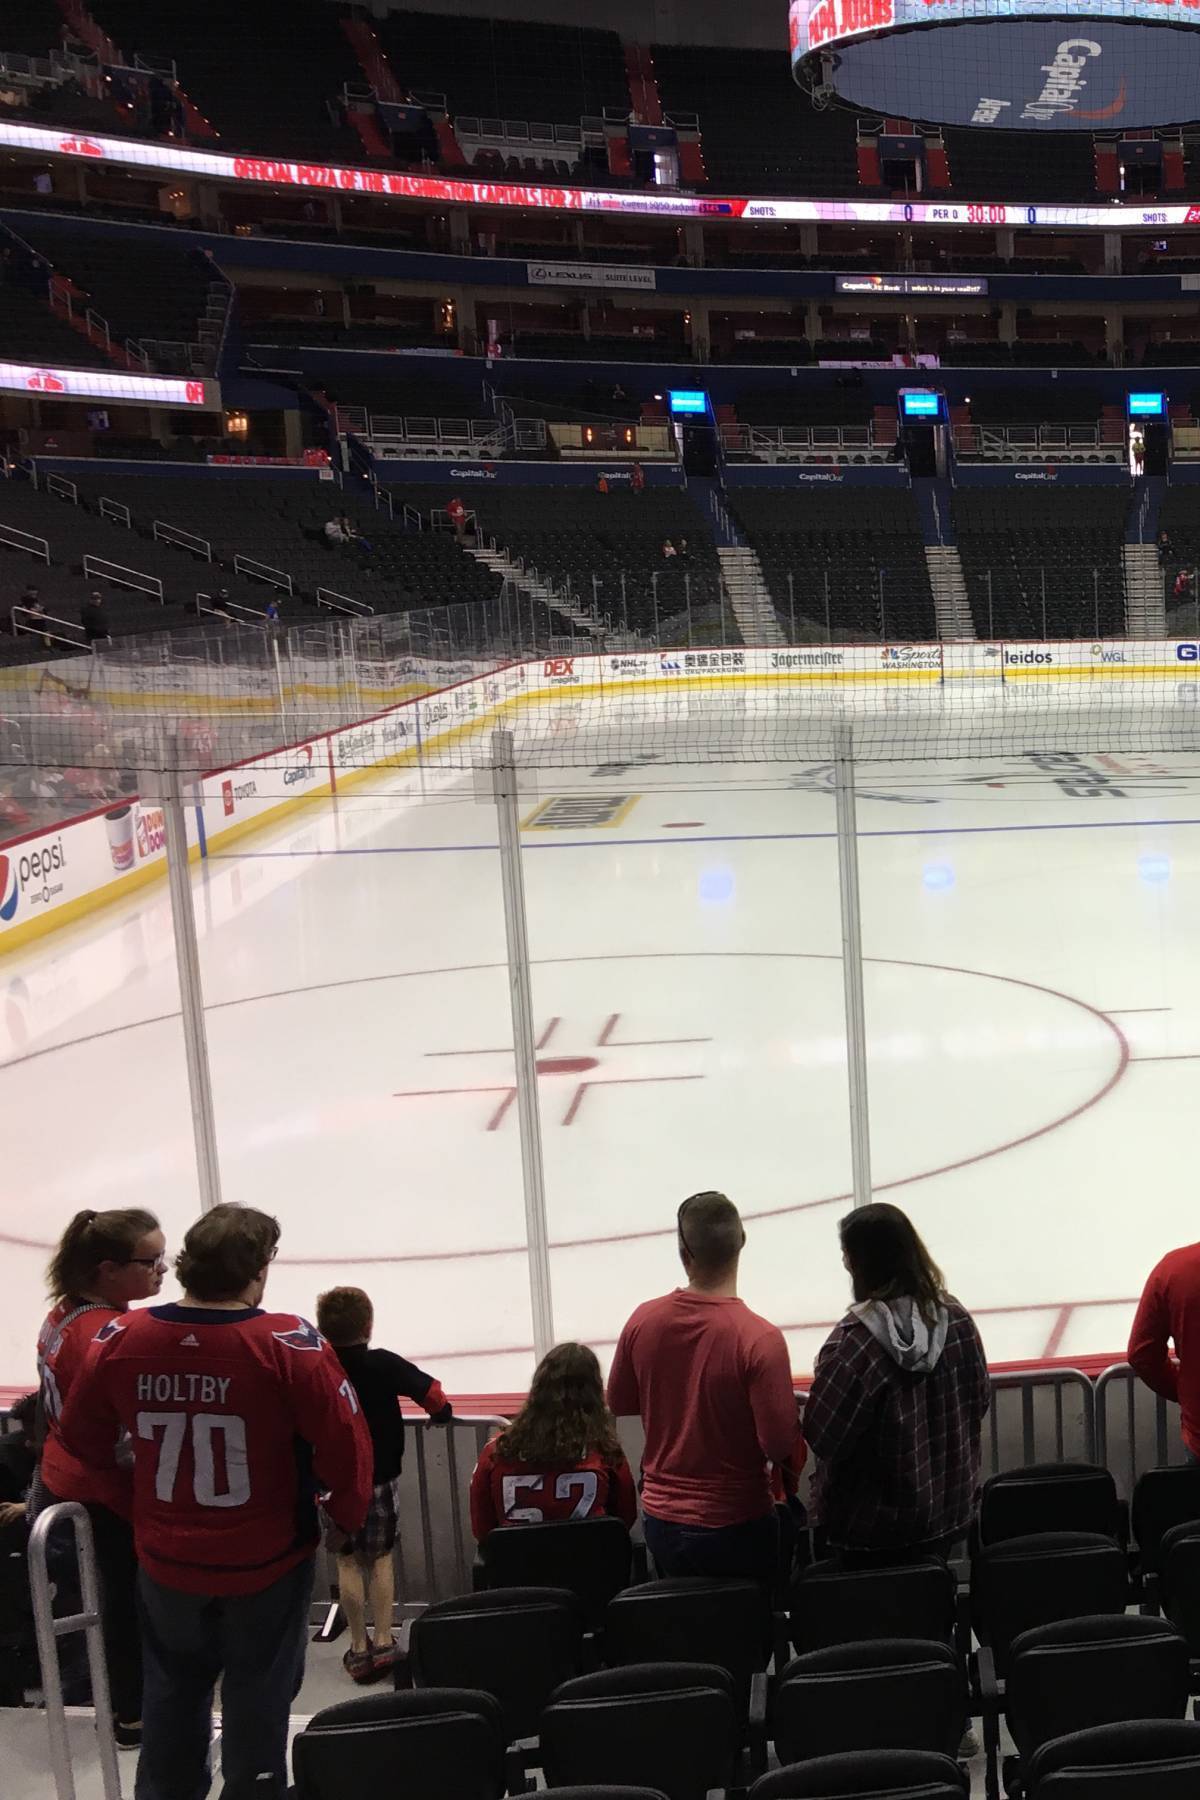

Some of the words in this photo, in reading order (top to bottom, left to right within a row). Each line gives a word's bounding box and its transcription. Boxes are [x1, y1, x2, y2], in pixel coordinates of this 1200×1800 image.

[904, 204, 913, 222] 0
[933, 209, 949, 219] PER
[967, 205, 1006, 223] 30:00
[1028, 206, 1036, 224] 0
[548, 271, 592, 281] LEXUS
[899, 646, 942, 660] Sports
[1005, 650, 1053, 665] leidos
[1101, 652, 1128, 663] WGL
[544, 659, 575, 677] DEX
[882, 660, 941, 669] WASHINGTON
[234, 780, 257, 801] TOYOTA
[19, 837, 66, 892] pepsi
[137, 1373, 231, 1404] HOLTBY
[136, 1411, 251, 1508] 70
